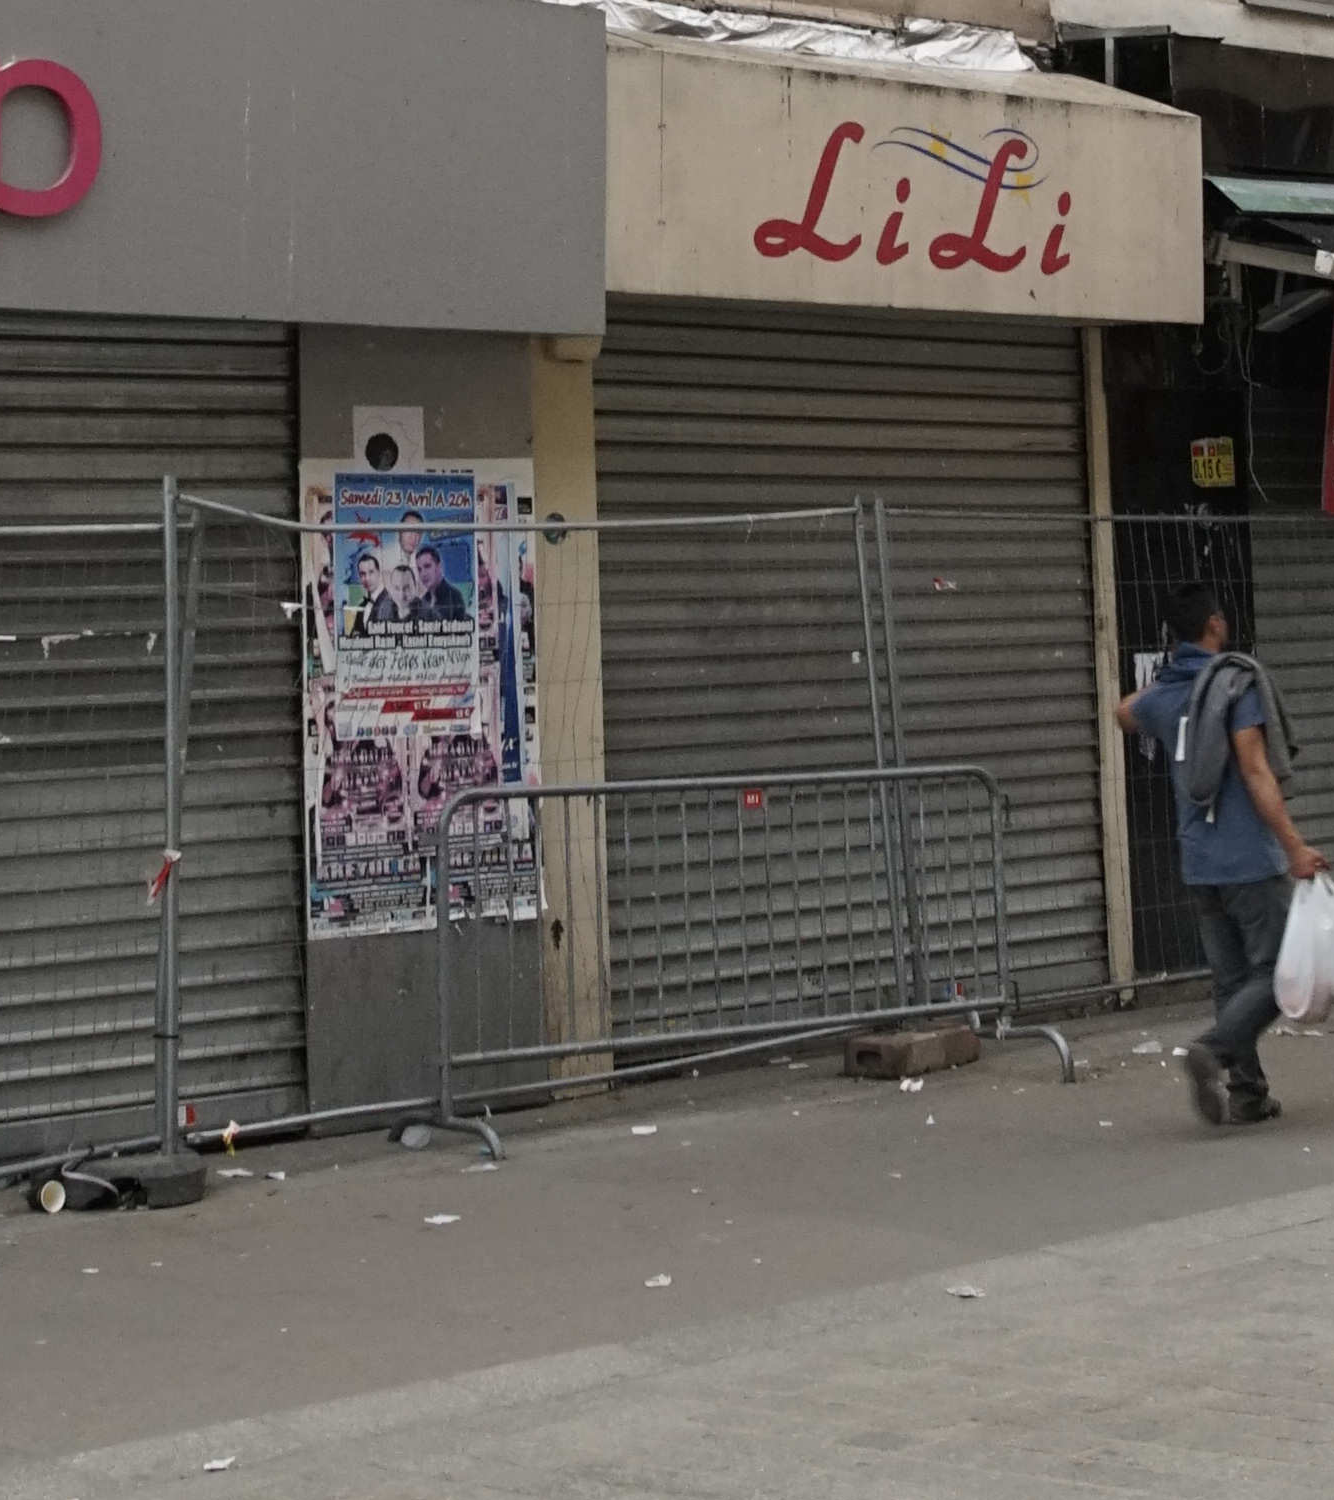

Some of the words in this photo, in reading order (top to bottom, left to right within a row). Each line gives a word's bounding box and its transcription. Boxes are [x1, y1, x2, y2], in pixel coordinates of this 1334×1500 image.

[340, 486, 383, 507] Samedi
[385, 489, 402, 507] 23
[405, 487, 433, 508] Avril
[448, 489, 471, 508] 20h
